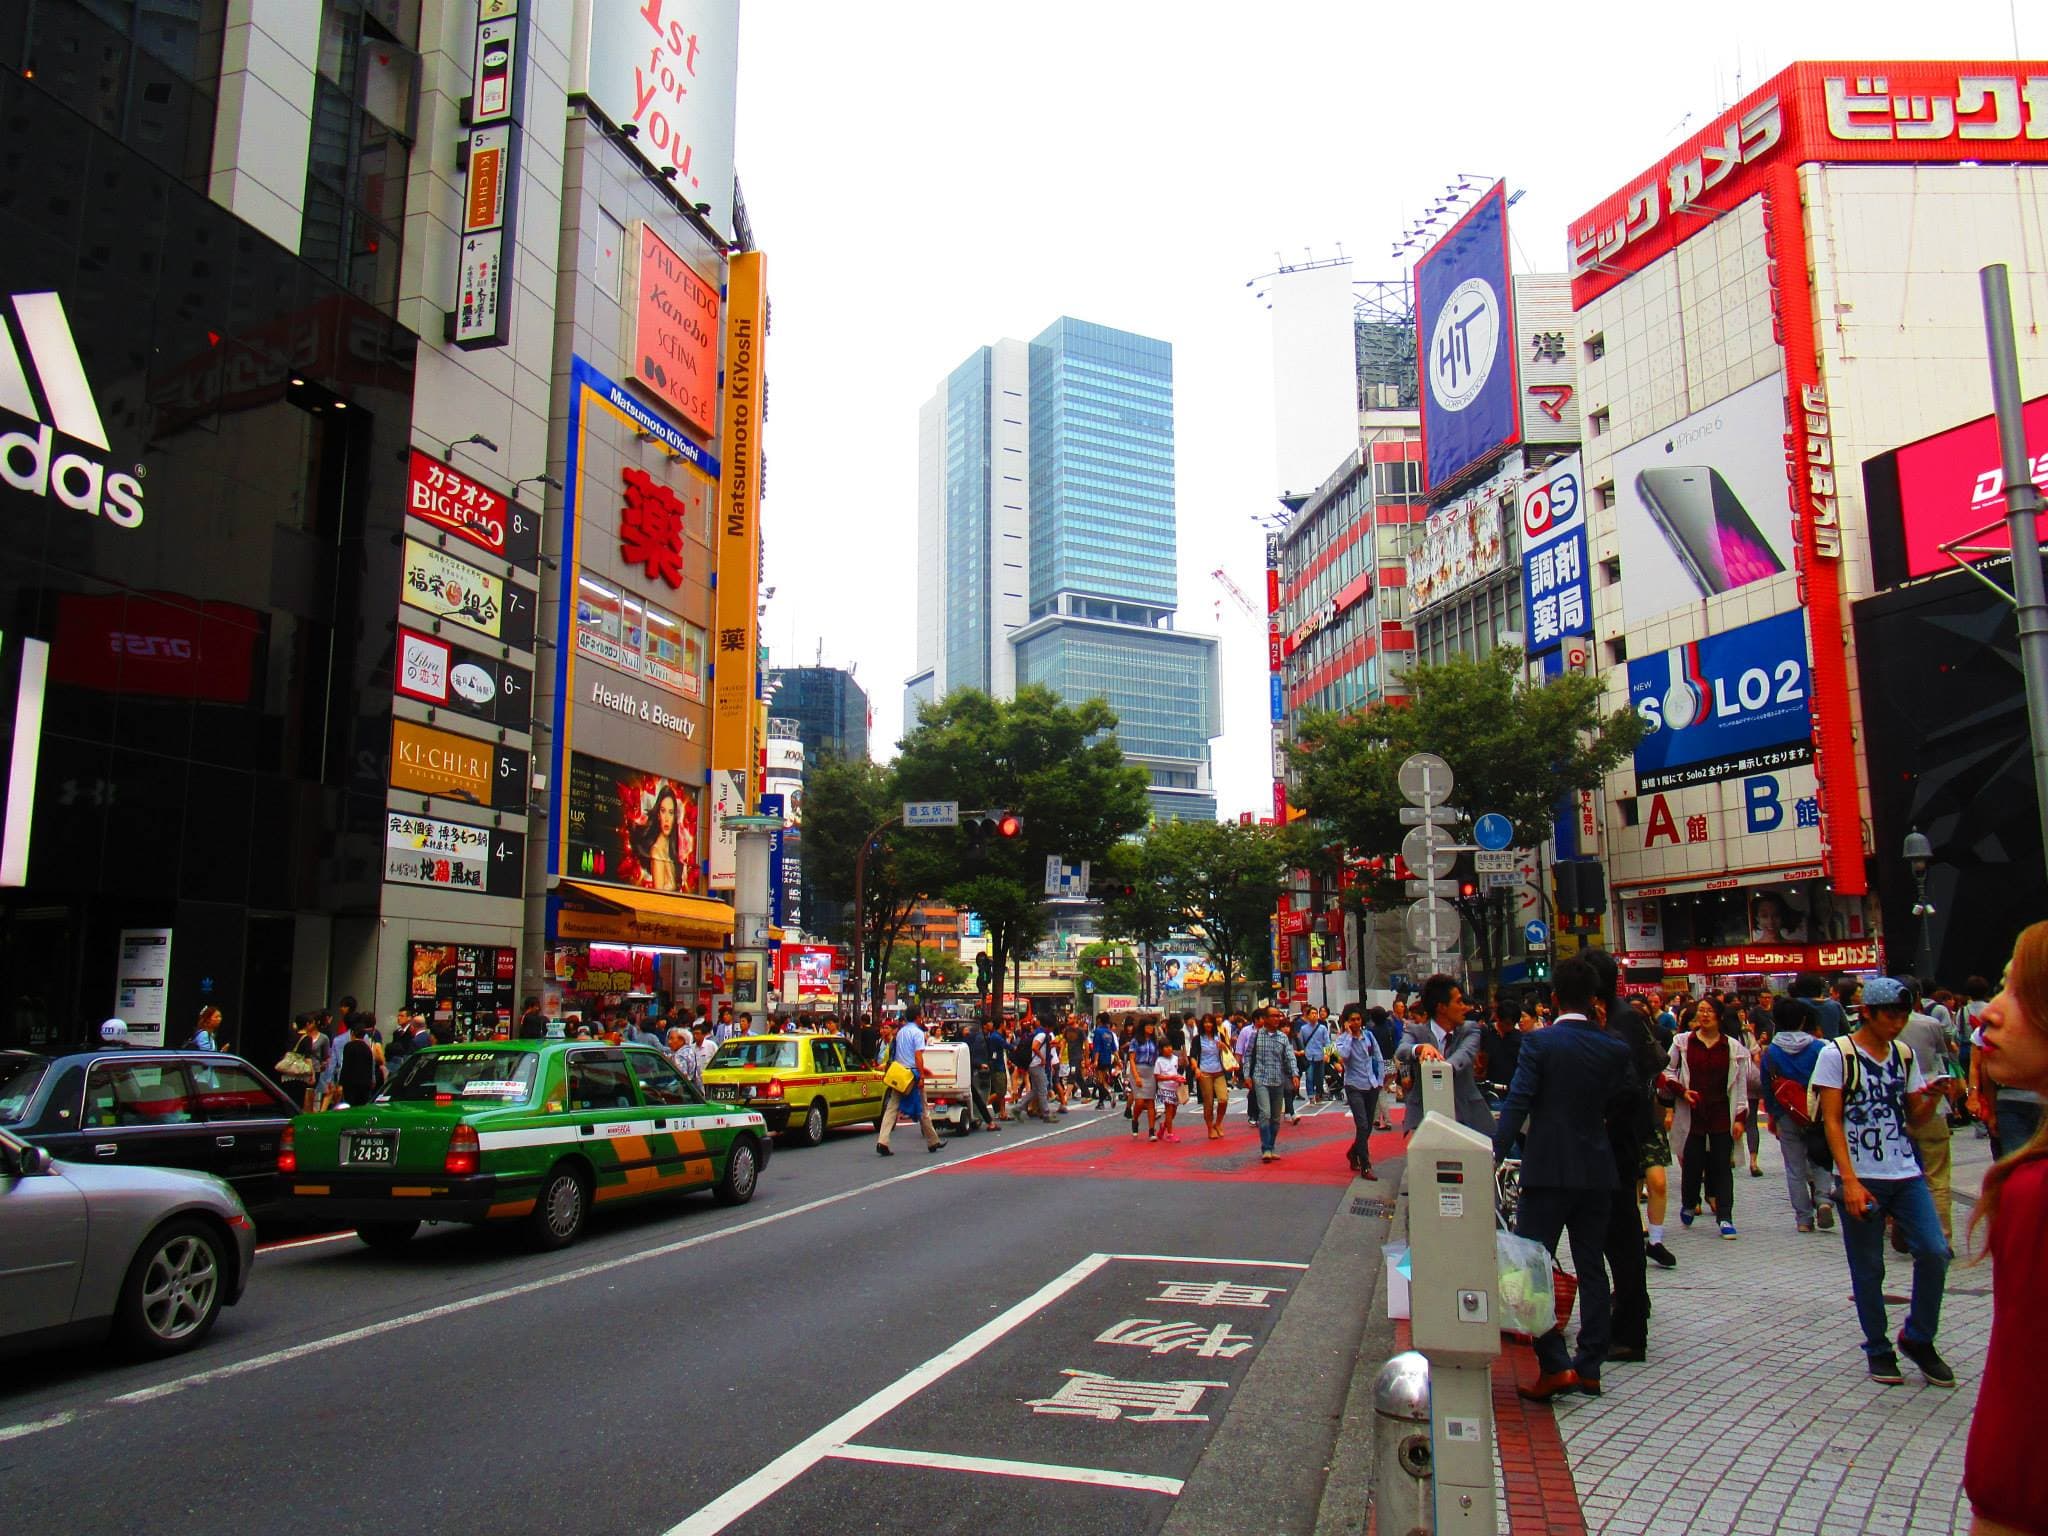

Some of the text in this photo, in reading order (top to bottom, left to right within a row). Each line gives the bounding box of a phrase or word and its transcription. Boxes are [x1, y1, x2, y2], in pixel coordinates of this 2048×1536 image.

[651, 47, 687, 104] for
[1570, 94, 1783, 279] ビックカメラ
[643, 245, 717, 320] SHISEIDO
[650, 284, 708, 348] Kanebo
[611, 387, 666, 438] Matsumoto
[1675, 416, 1723, 450] iPhone 6
[427, 466, 495, 512] カラオケ
[728, 404, 749, 537] Matsumoto
[412, 480, 504, 546] BIG ECHO
[620, 466, 686, 590] 薬
[1525, 473, 1579, 538] OS
[1530, 535, 1581, 597] 調剤
[1532, 584, 1584, 644] 薬局
[407, 645, 440, 672] Libra
[721, 627, 745, 652] 薬
[407, 666, 441, 688] の恋文
[1633, 680, 1653, 693] NEW
[592, 682, 696, 741] Health & Beauty
[1686, 768, 1708, 780] Solo2
[389, 817, 488, 848] 完全個室 博多もつ鍋
[570, 809, 586, 823] LUX
[908, 805, 953, 817] 道玄坂下
[1745, 953, 1804, 964] ビックカメラ
[1818, 945, 1877, 966] ビックカメラ
[357, 1146, 390, 1161] 24-93
